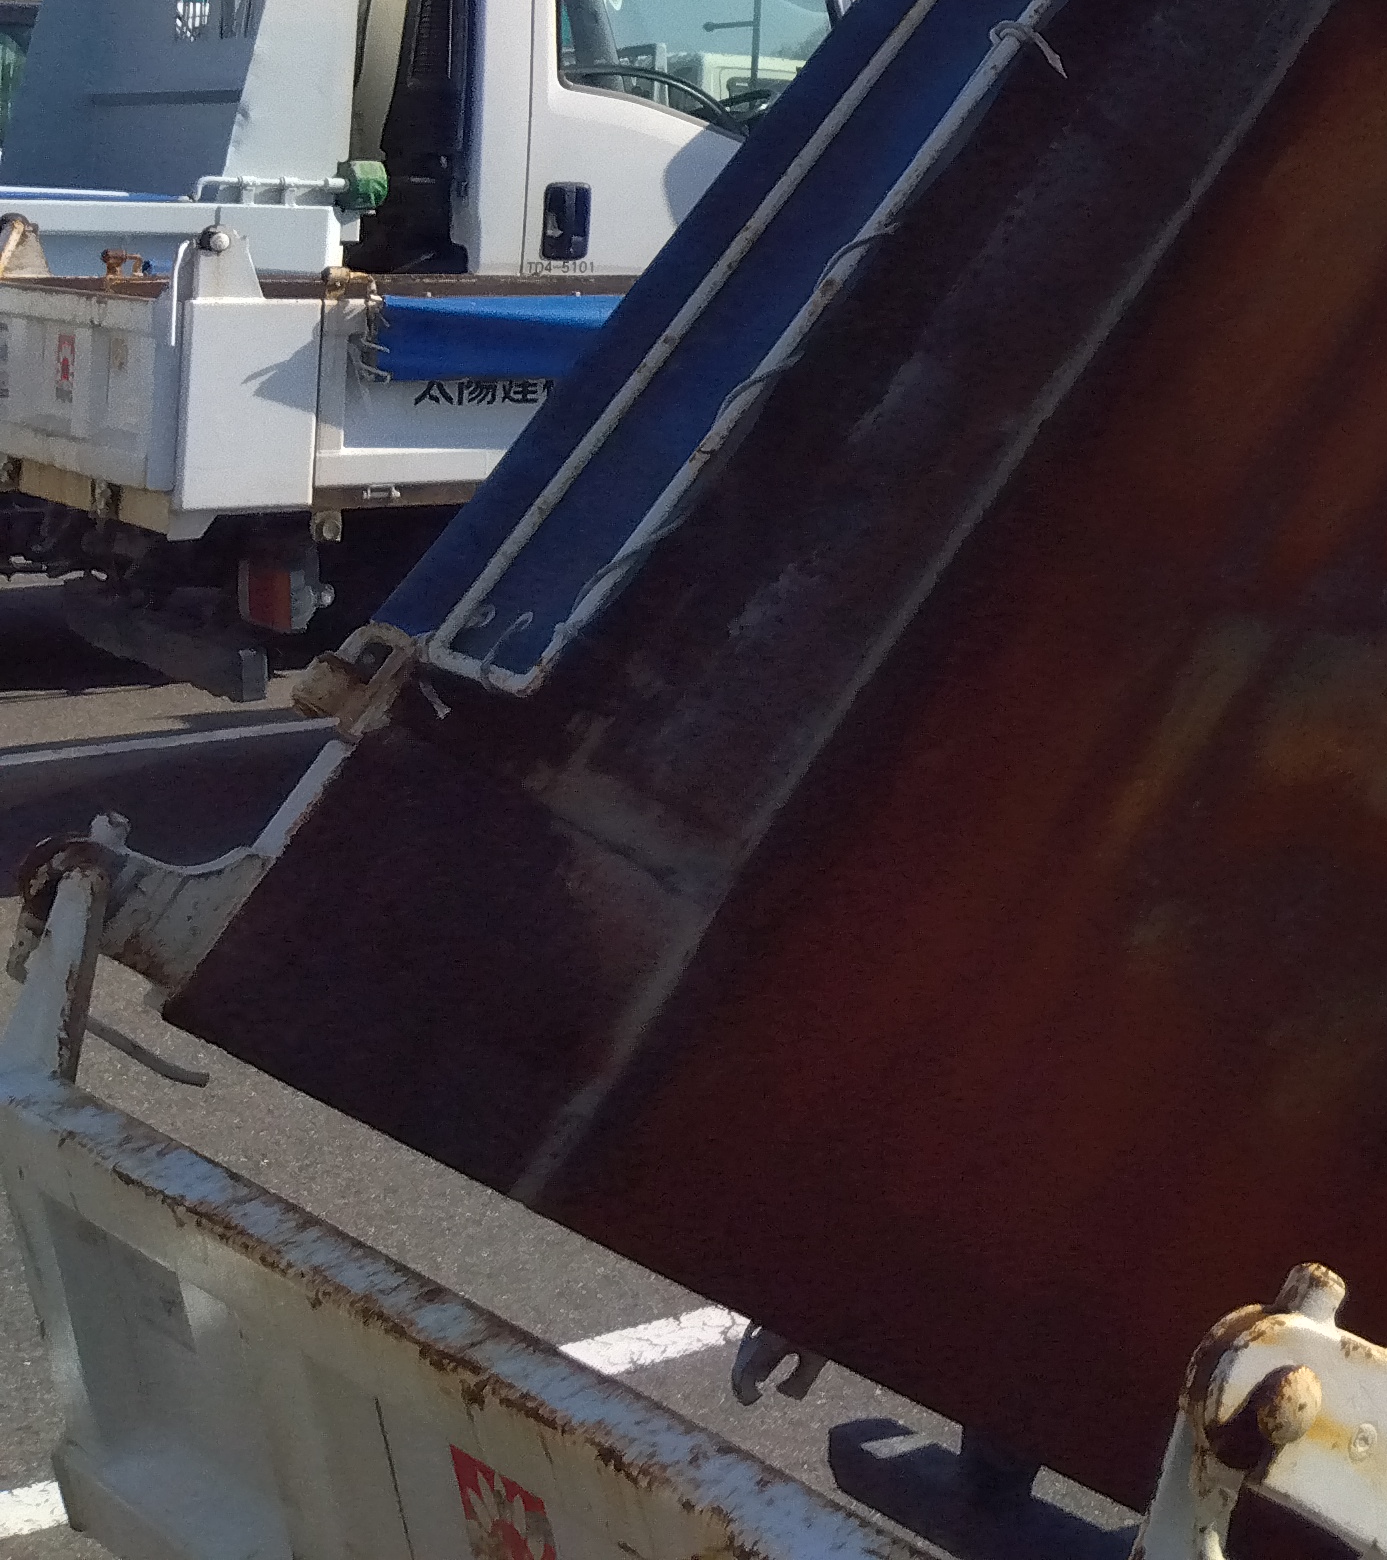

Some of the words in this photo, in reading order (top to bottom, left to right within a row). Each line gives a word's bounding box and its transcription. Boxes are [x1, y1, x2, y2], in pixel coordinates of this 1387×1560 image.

[527, 261, 595, 274] TD4-5101
[413, 379, 554, 406] 太陽建
